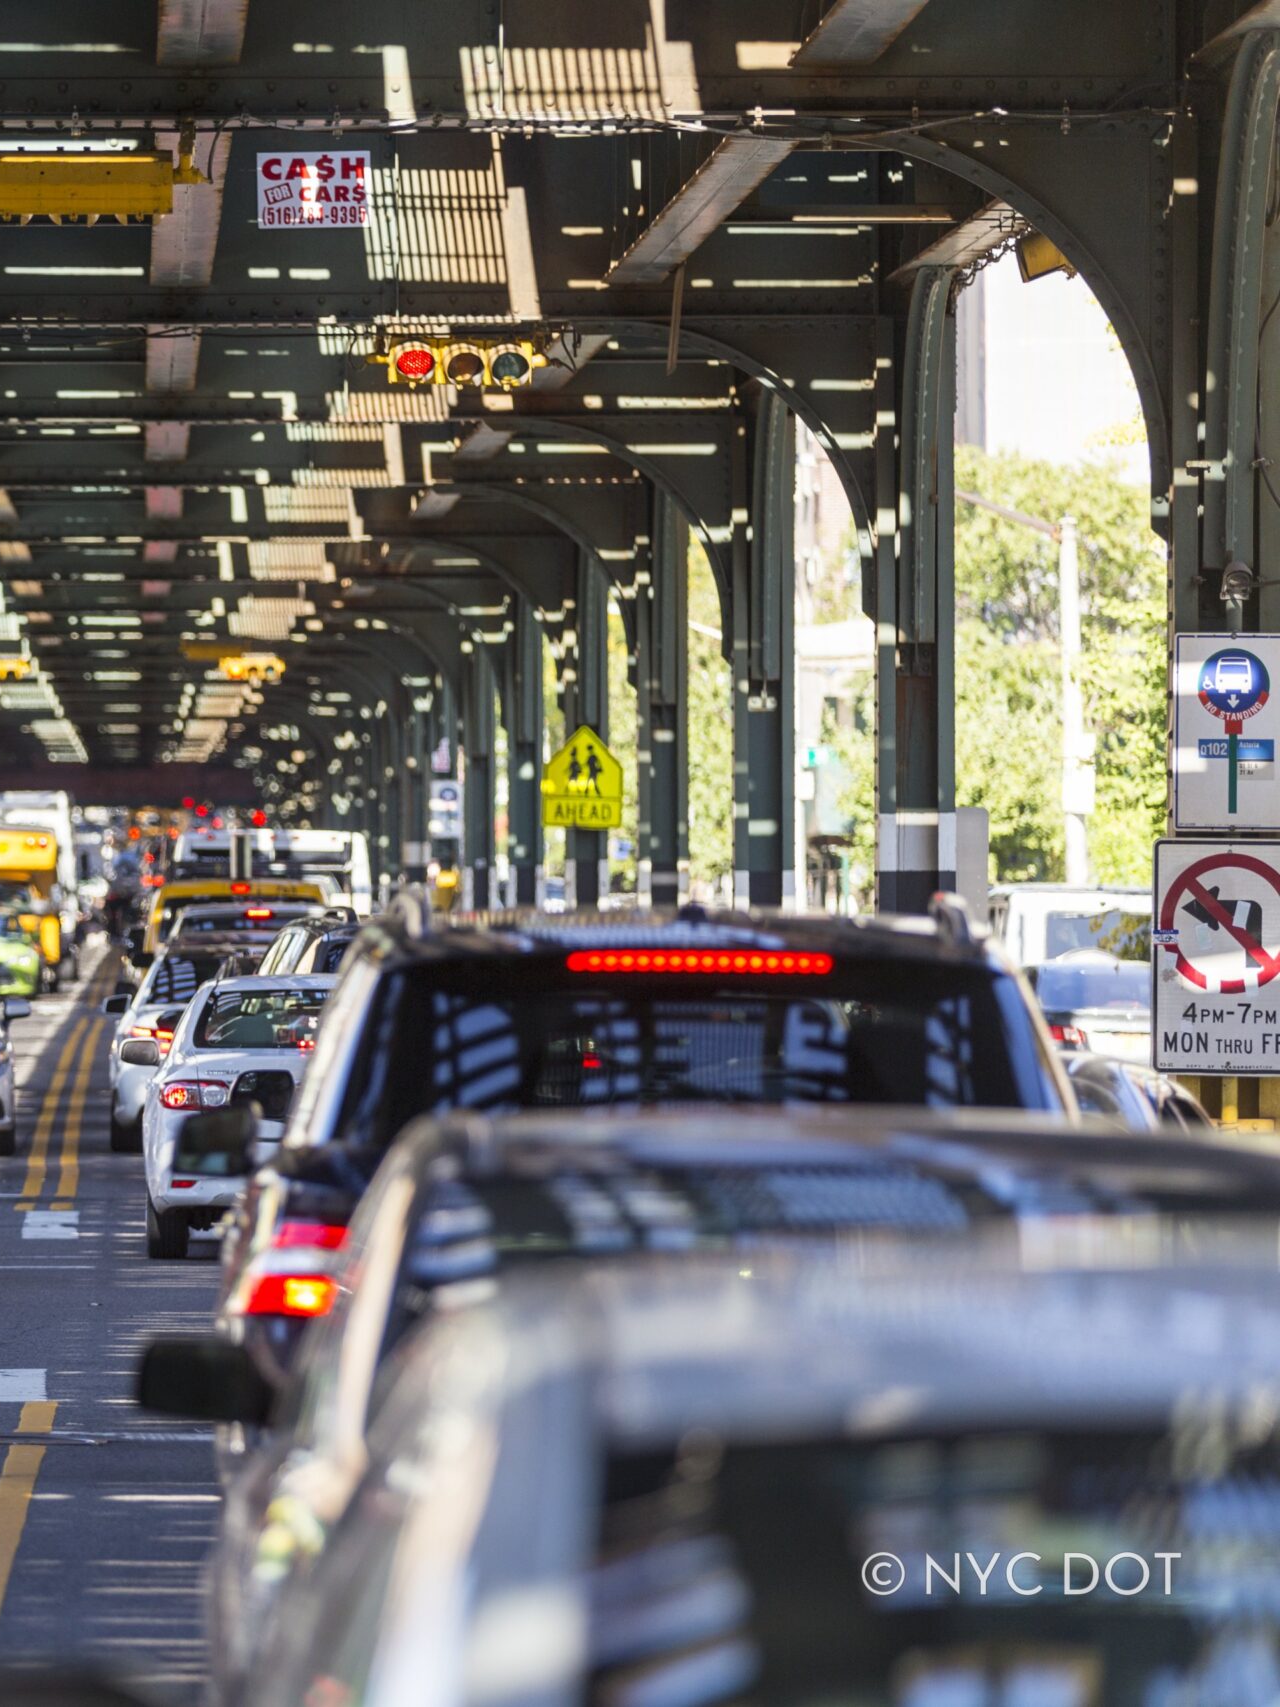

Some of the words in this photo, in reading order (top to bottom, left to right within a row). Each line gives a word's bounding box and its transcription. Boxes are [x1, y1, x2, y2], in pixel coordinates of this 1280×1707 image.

[261, 154, 365, 183] CA$H
[266, 184, 292, 204] FOR
[1205, 701, 1217, 714] NO
[1219, 701, 1263, 721] STANDING
[554, 802, 613, 822] AHEAD
[1164, 1031, 1208, 1054] MON
[1215, 1039, 1253, 1055] THRU
